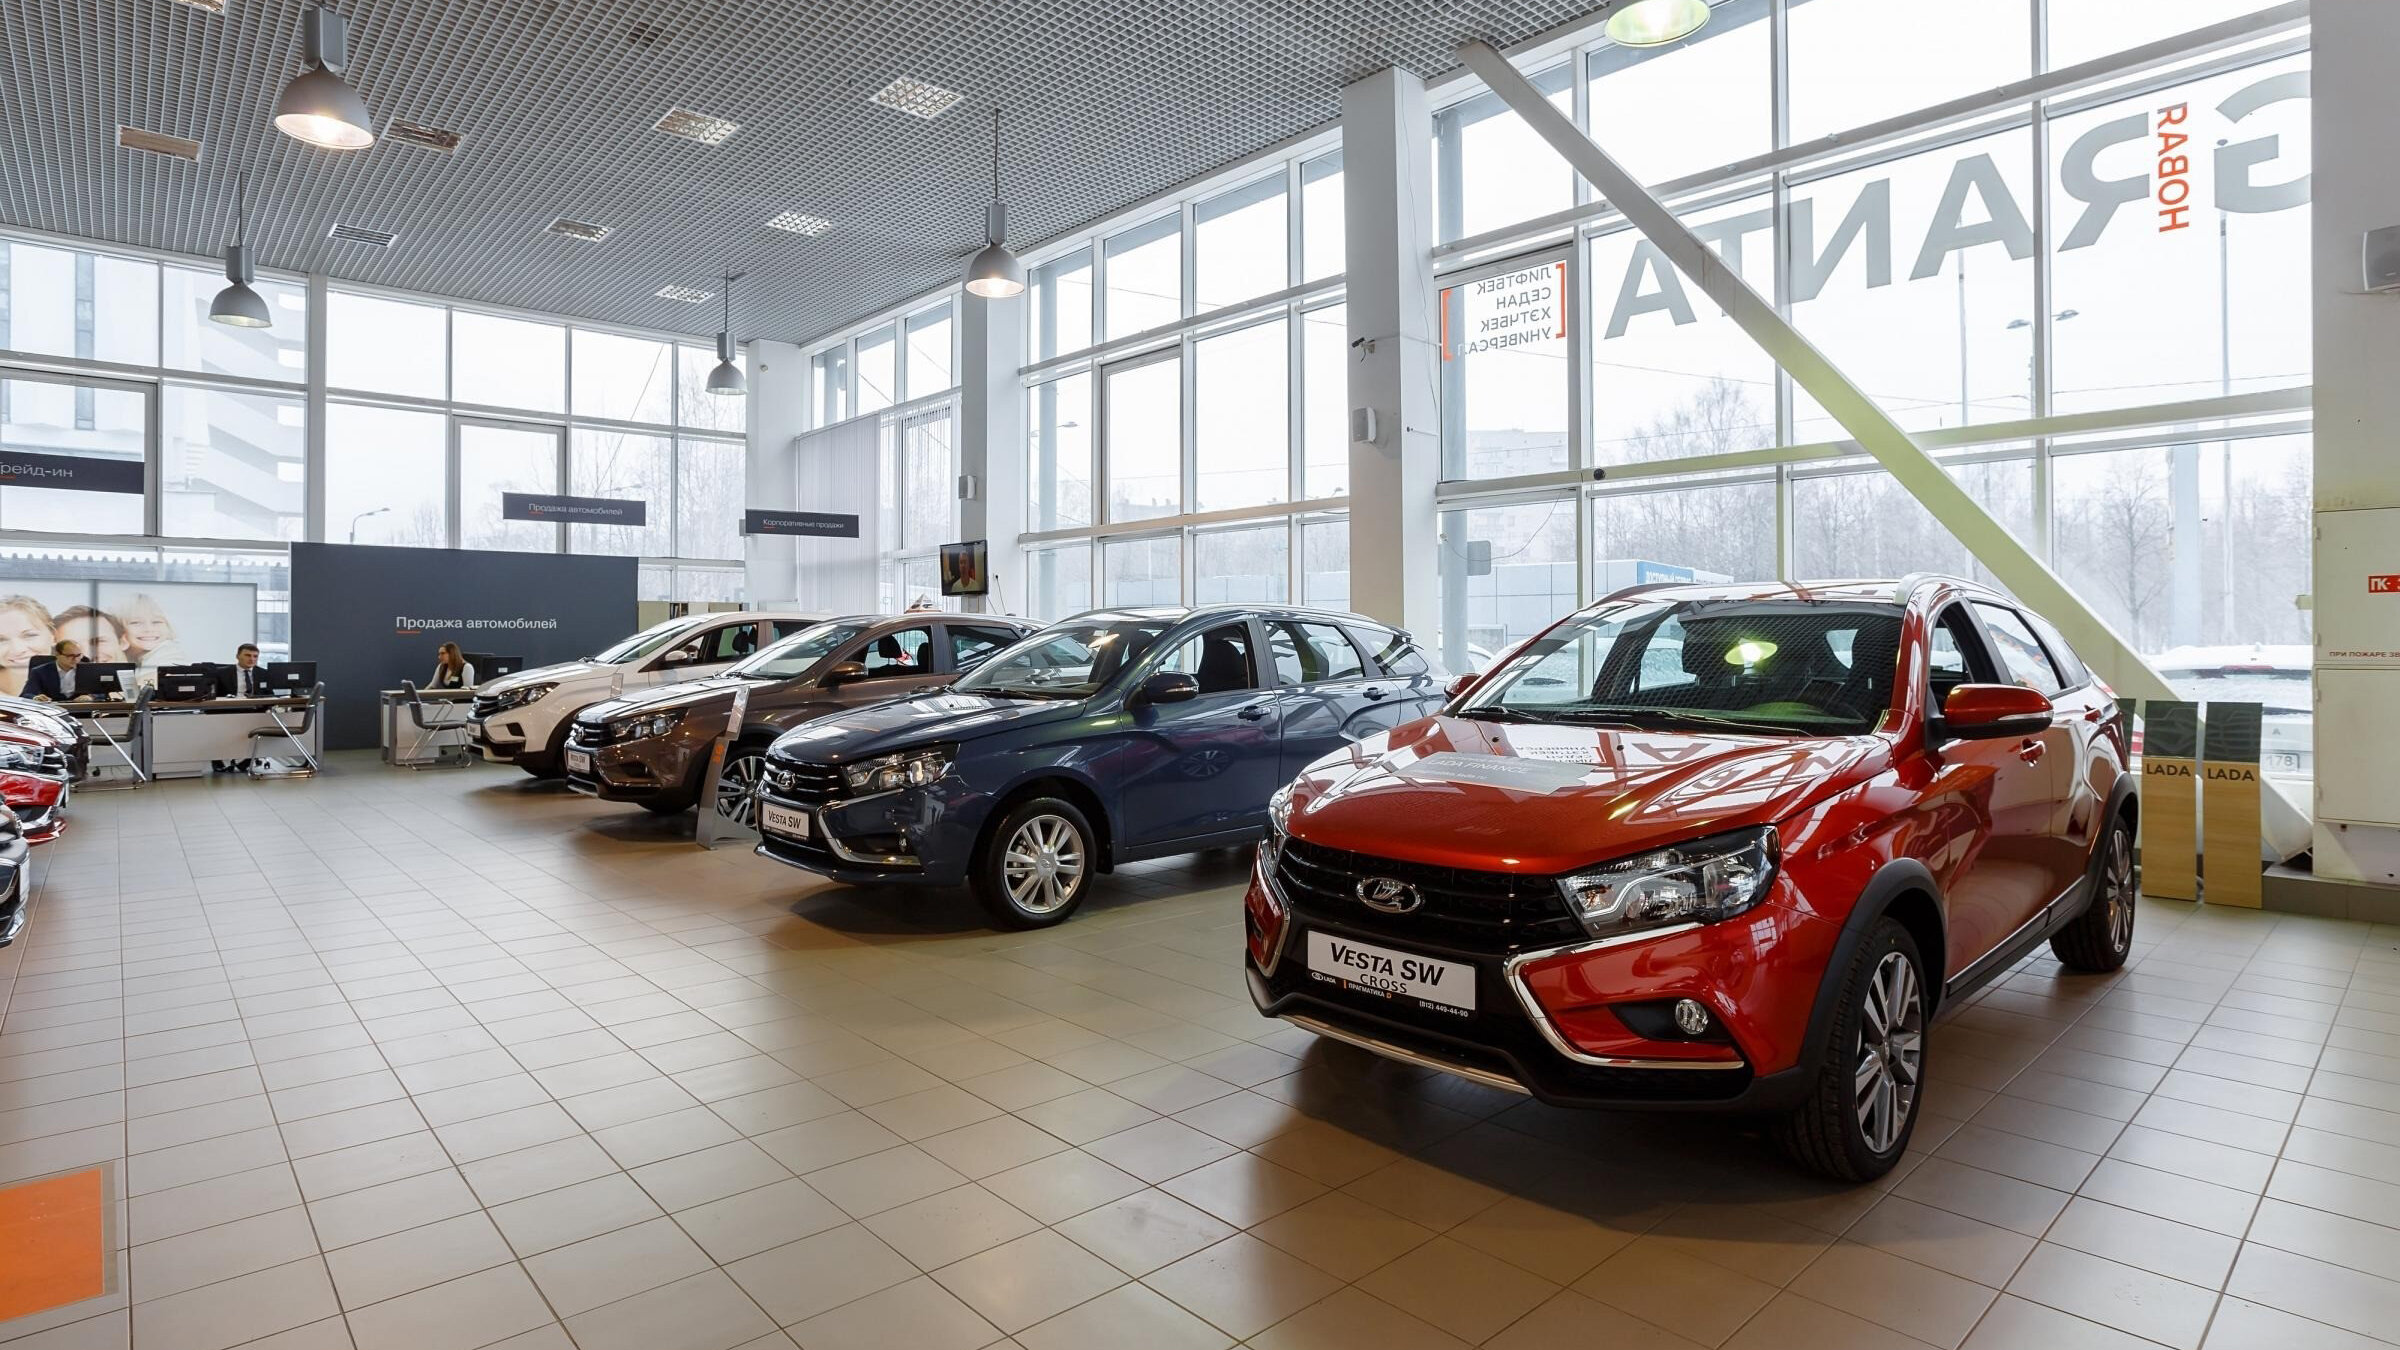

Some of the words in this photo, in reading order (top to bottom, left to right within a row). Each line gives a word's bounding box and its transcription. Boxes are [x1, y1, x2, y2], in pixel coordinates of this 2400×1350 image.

[0, 462, 73, 478] рейд-ин
[528, 503, 566, 514] Продажа
[568, 506, 623, 516] автомобилей
[763, 518, 815, 529] Корпоративные
[396, 616, 463, 630] Продажа
[466, 617, 557, 629] автомобилей
[2146, 763, 2191, 777] LADA
[2207, 767, 2255, 782] LADA
[768, 809, 787, 825] VESTA
[788, 816, 801, 829] SW
[1330, 942, 1394, 976] VESTA
[1400, 959, 1445, 986] SW
[1360, 973, 1408, 994] CROSS
